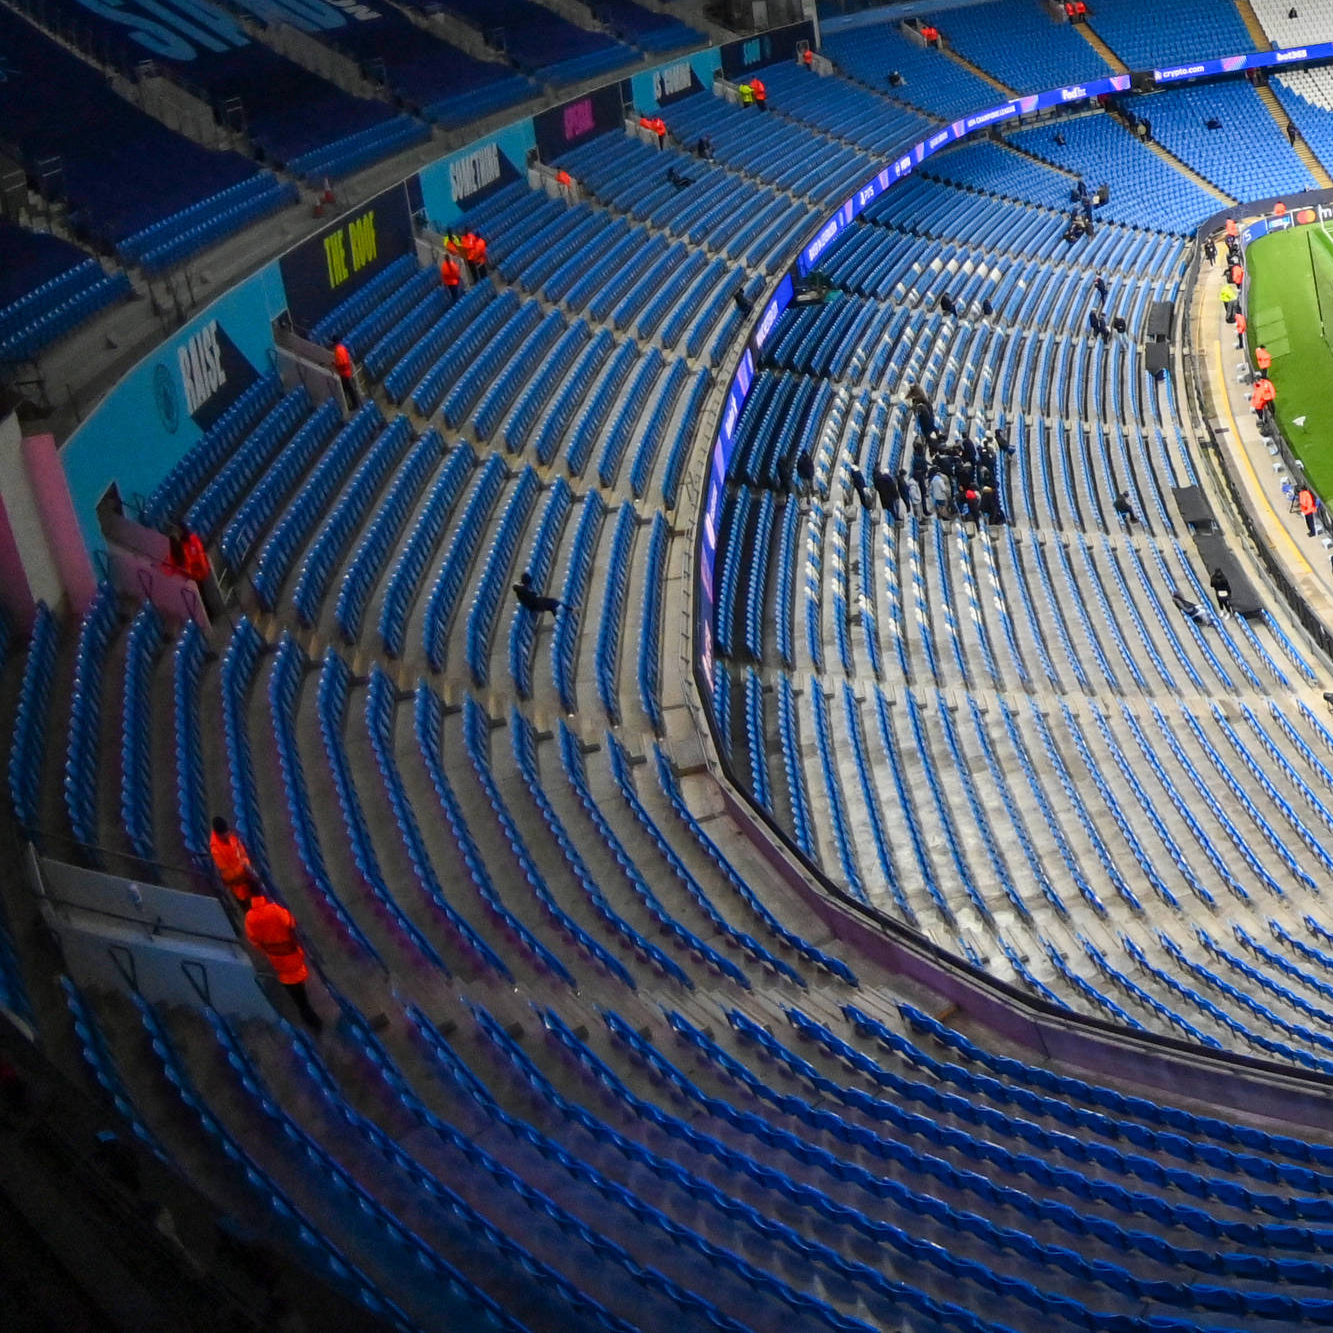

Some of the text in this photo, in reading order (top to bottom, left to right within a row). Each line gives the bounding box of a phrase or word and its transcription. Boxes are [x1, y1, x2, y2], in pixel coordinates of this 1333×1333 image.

[1162, 64, 1205, 79] crypto.com
[323, 210, 377, 289] THE ROOF
[177, 319, 227, 416] RAISE
